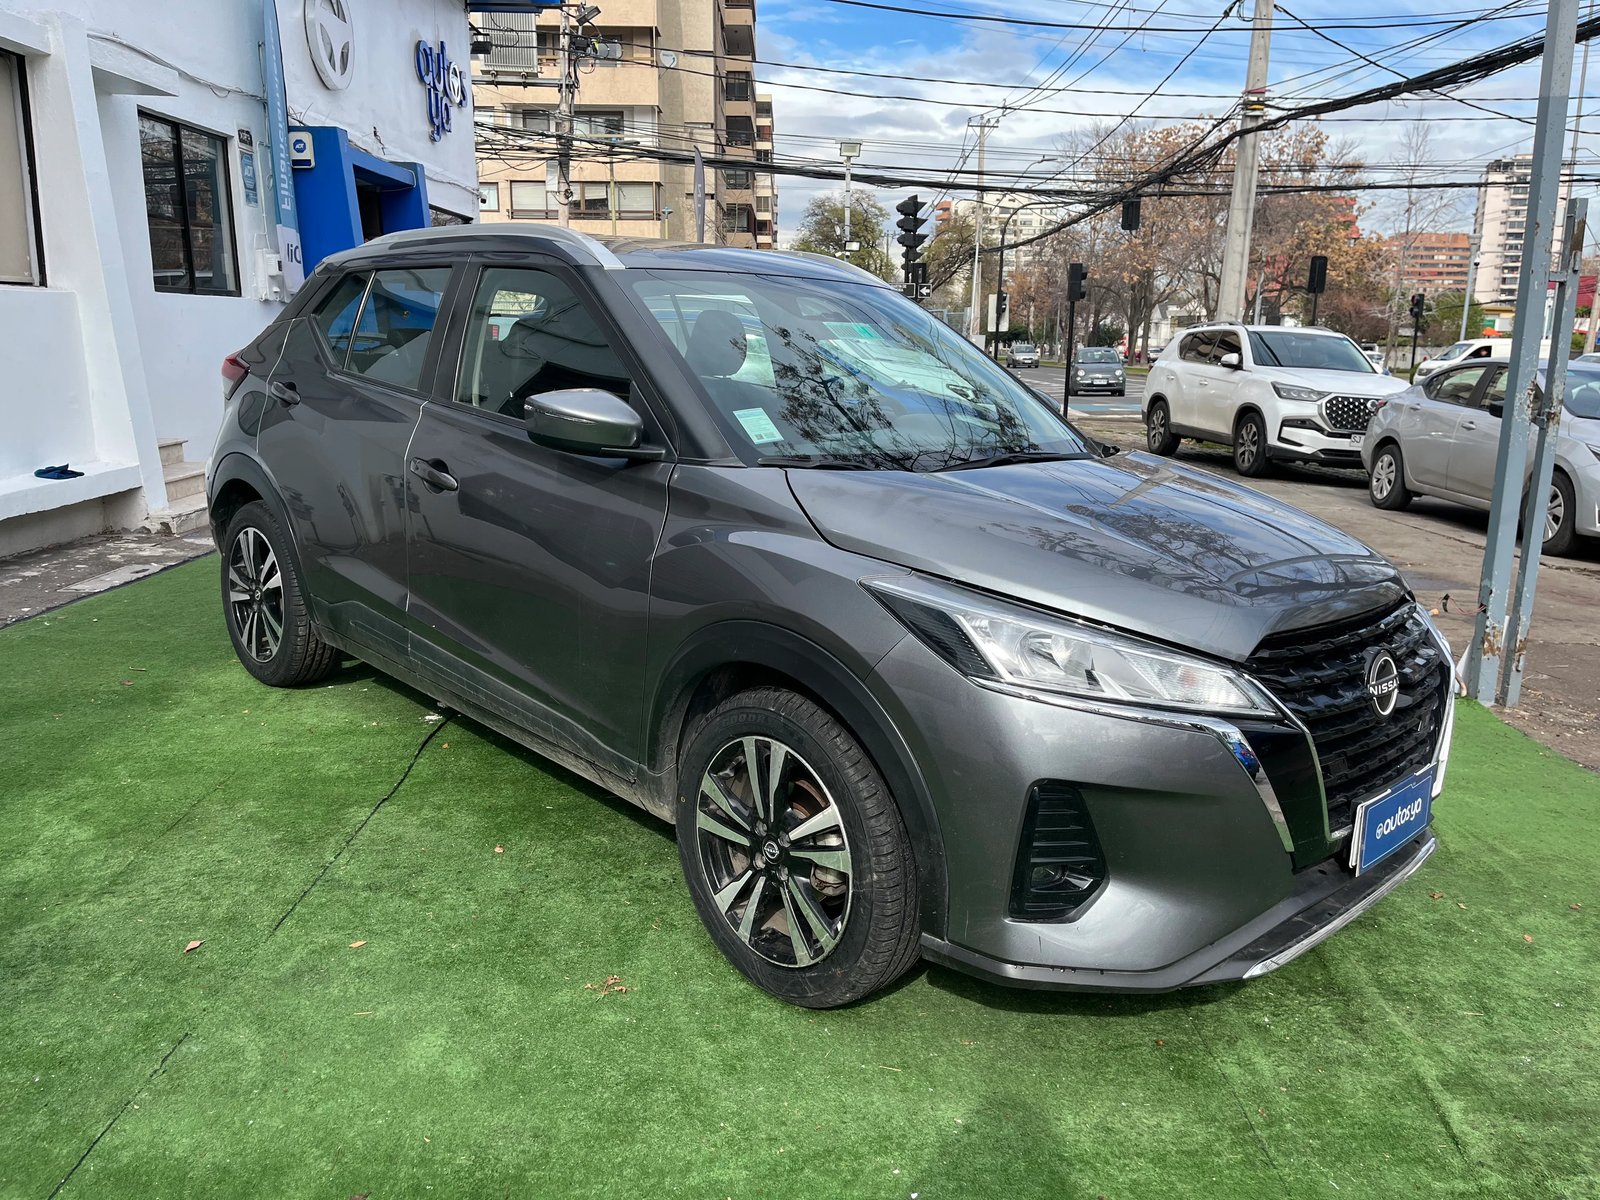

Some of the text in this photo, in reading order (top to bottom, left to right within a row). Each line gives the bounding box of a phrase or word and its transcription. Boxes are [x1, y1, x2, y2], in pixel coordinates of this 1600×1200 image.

[415, 39, 468, 109] autos
[427, 87, 453, 142] ya
[1383, 797, 1423, 835] autosya
